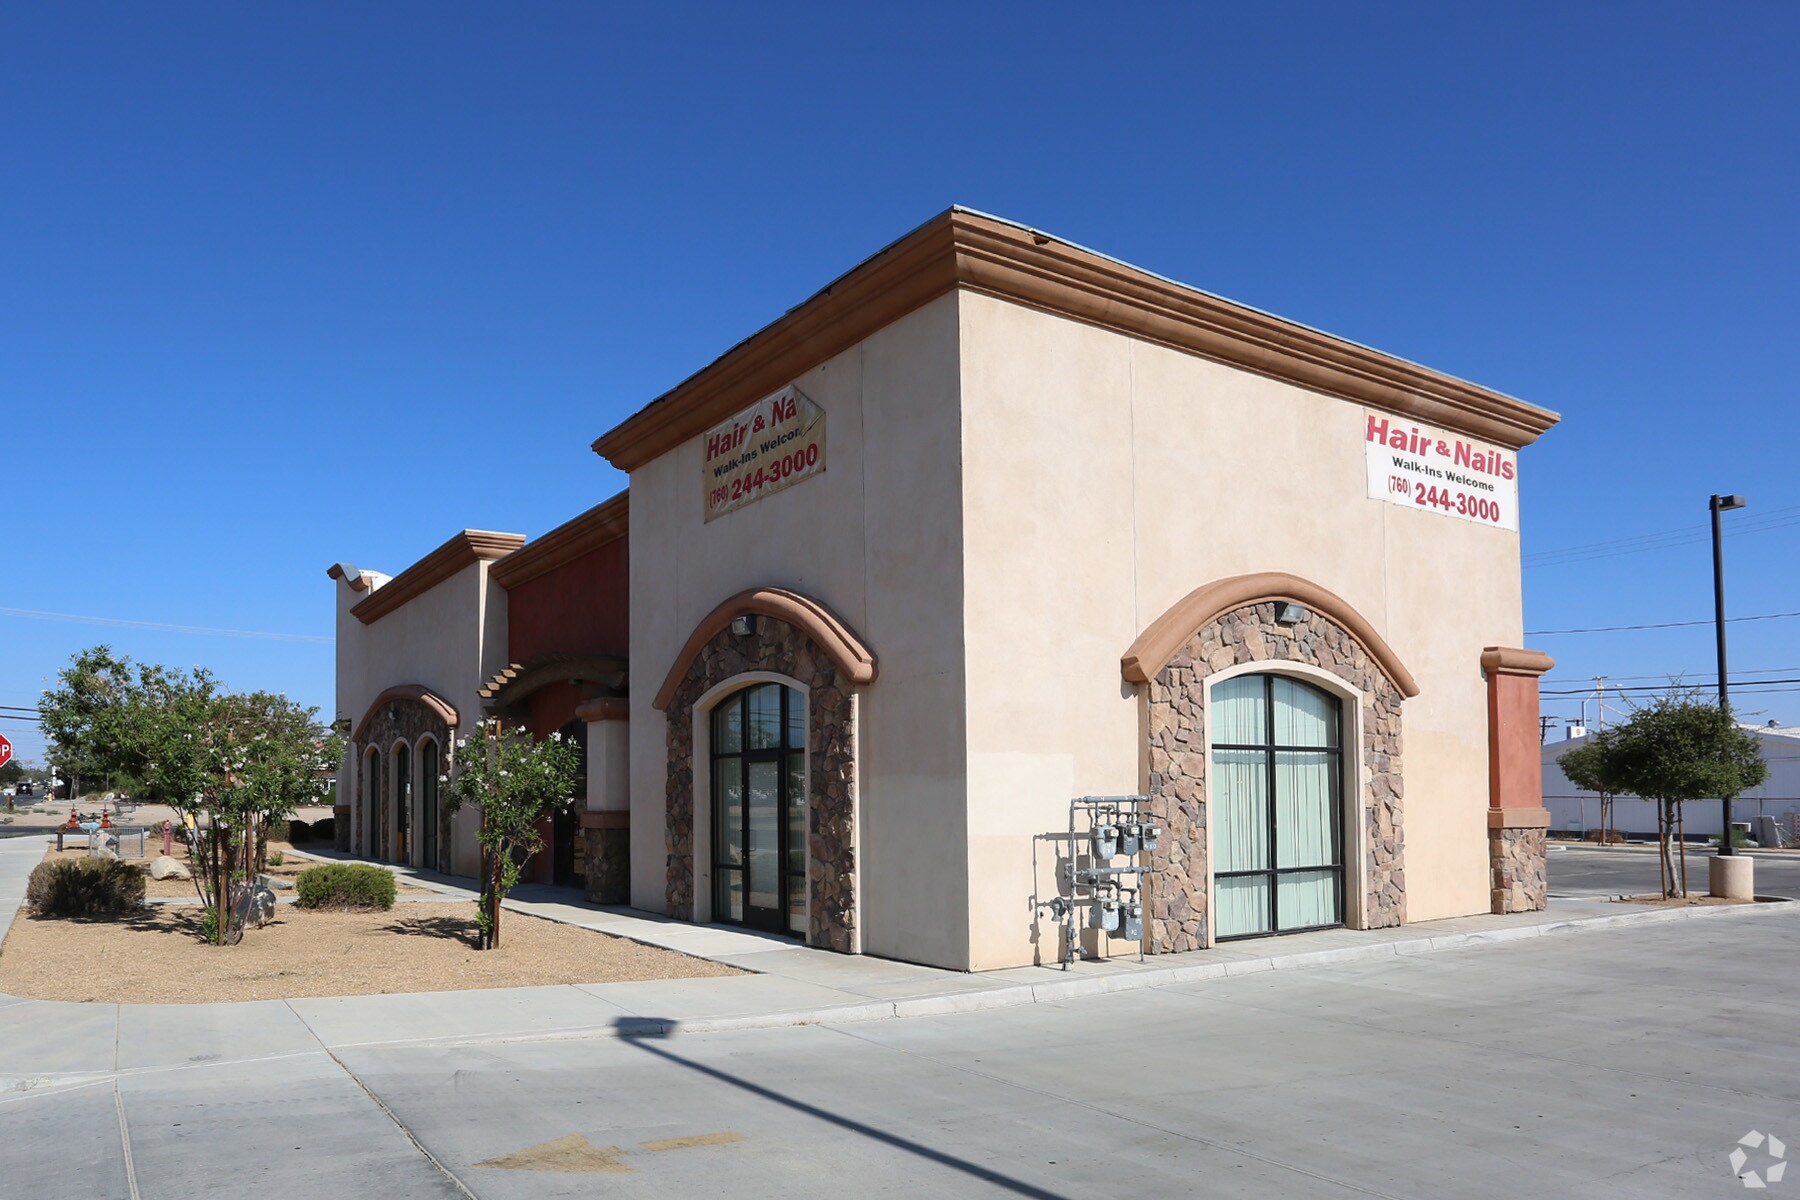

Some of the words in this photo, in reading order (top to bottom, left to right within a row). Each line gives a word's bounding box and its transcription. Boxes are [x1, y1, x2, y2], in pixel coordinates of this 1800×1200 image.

[707, 422, 748, 461] Hair
[752, 415, 765, 434] &
[771, 396, 797, 427] Na
[1366, 415, 1432, 457] Hair
[1435, 440, 1451, 457] &
[1454, 440, 1514, 481] Nails
[709, 484, 729, 509] (760)
[731, 443, 818, 501] 244-3000
[713, 449, 757, 478] Walk-Ins
[1392, 456, 1443, 479] Walk-Ins
[1445, 470, 1495, 492] Welcome
[1388, 474, 1411, 498] (760)
[1415, 482, 1500, 522] 244-3000
[0, 744, 9, 756] P
